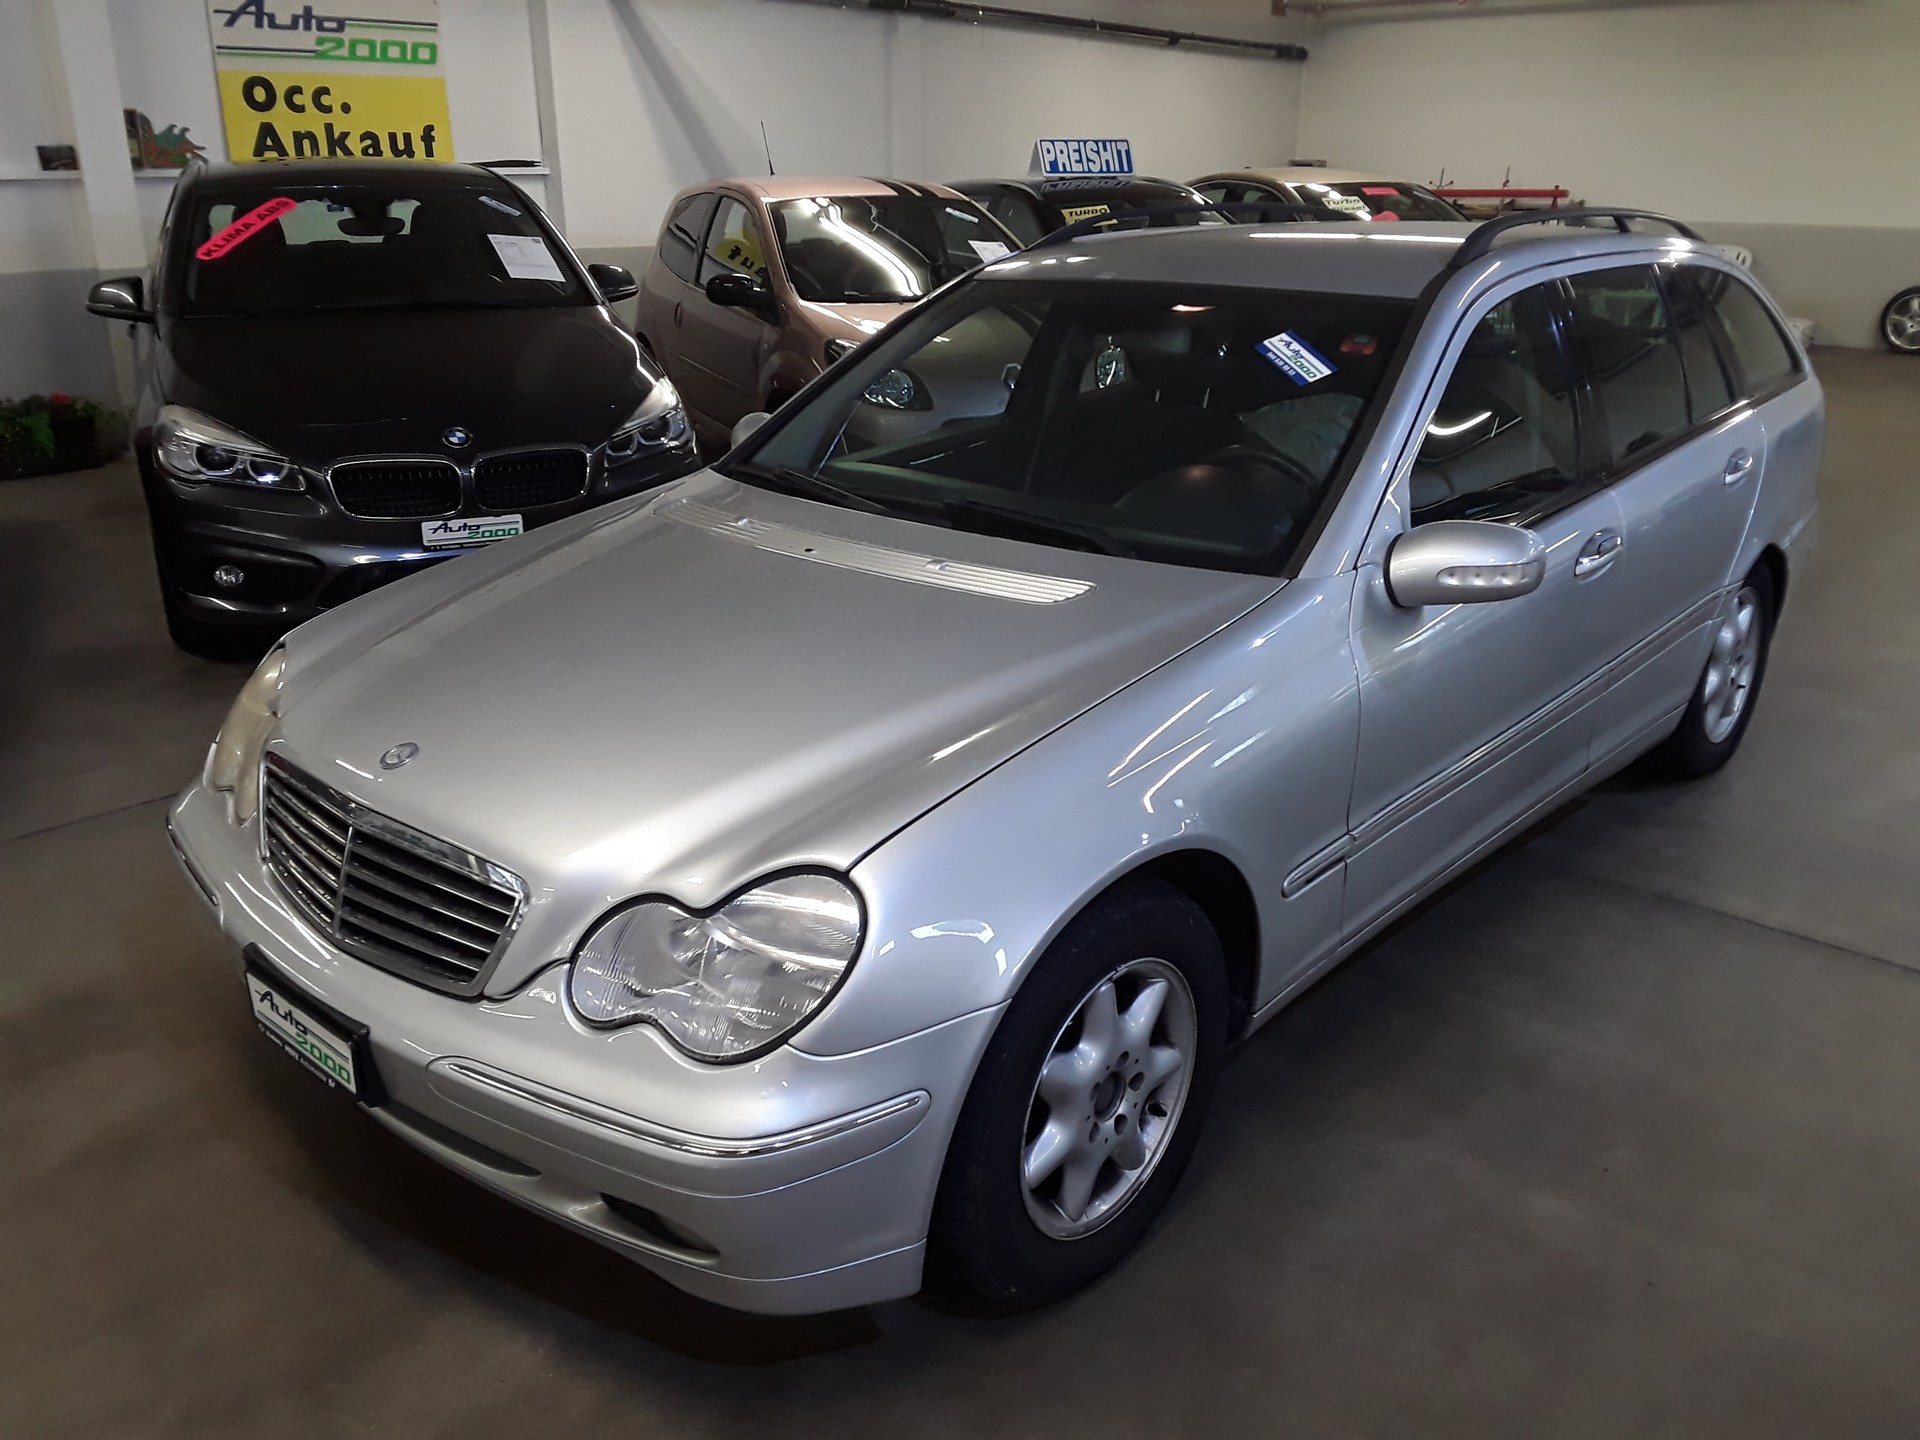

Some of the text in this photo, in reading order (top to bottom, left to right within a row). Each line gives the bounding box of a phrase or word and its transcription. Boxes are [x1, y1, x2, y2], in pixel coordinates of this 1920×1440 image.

[214, 0, 346, 33] Auto
[314, 36, 438, 65] 2000
[242, 75, 352, 114] Occ.
[252, 122, 436, 159] Ankauf
[1040, 140, 1129, 173] PREISHIT
[1068, 207, 1108, 217] TURBO
[1324, 198, 1360, 206] Turbo
[201, 200, 290, 258] KLIMA ABS
[1278, 337, 1303, 359] Auto
[428, 522, 481, 534] Auto
[468, 527, 519, 539] 2000
[254, 990, 309, 1037] Auto
[296, 1031, 352, 1085] 2000
